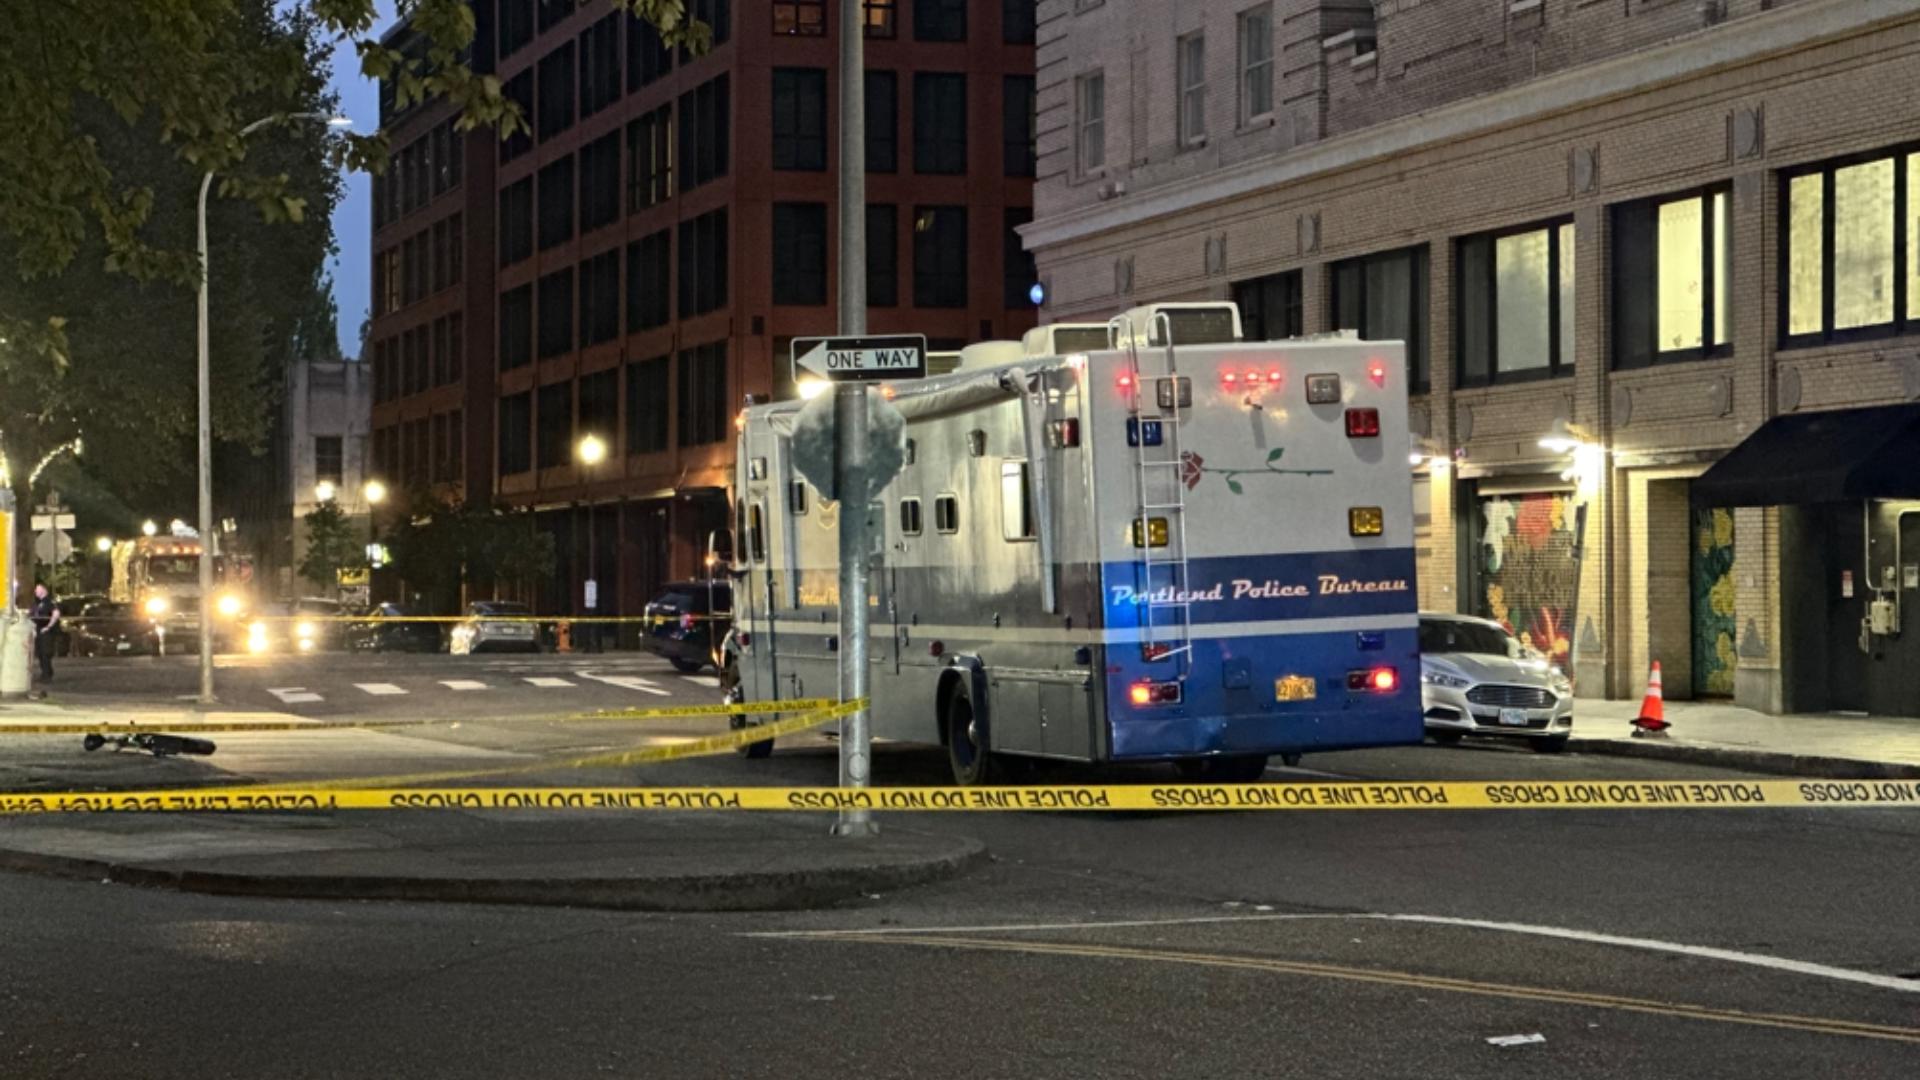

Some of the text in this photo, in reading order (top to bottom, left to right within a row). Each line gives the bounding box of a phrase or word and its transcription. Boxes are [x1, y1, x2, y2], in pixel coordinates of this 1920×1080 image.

[827, 350, 915, 368] ONE WAY
[1111, 575, 1408, 606] Portland Police Bureau
[547, 793, 585, 808] DO
[590, 793, 646, 808] LINE
[650, 792, 740, 808] POLICE
[787, 789, 1110, 807] POLICE LINE DO NOT CROSS
[1151, 786, 1448, 806] POLICE LINE DO NOT CROSS
[1485, 784, 1765, 803] POLICE LINE DO NOT CROSS
[1799, 783, 1870, 801] CROSS
[1874, 783, 1914, 801] NOT
